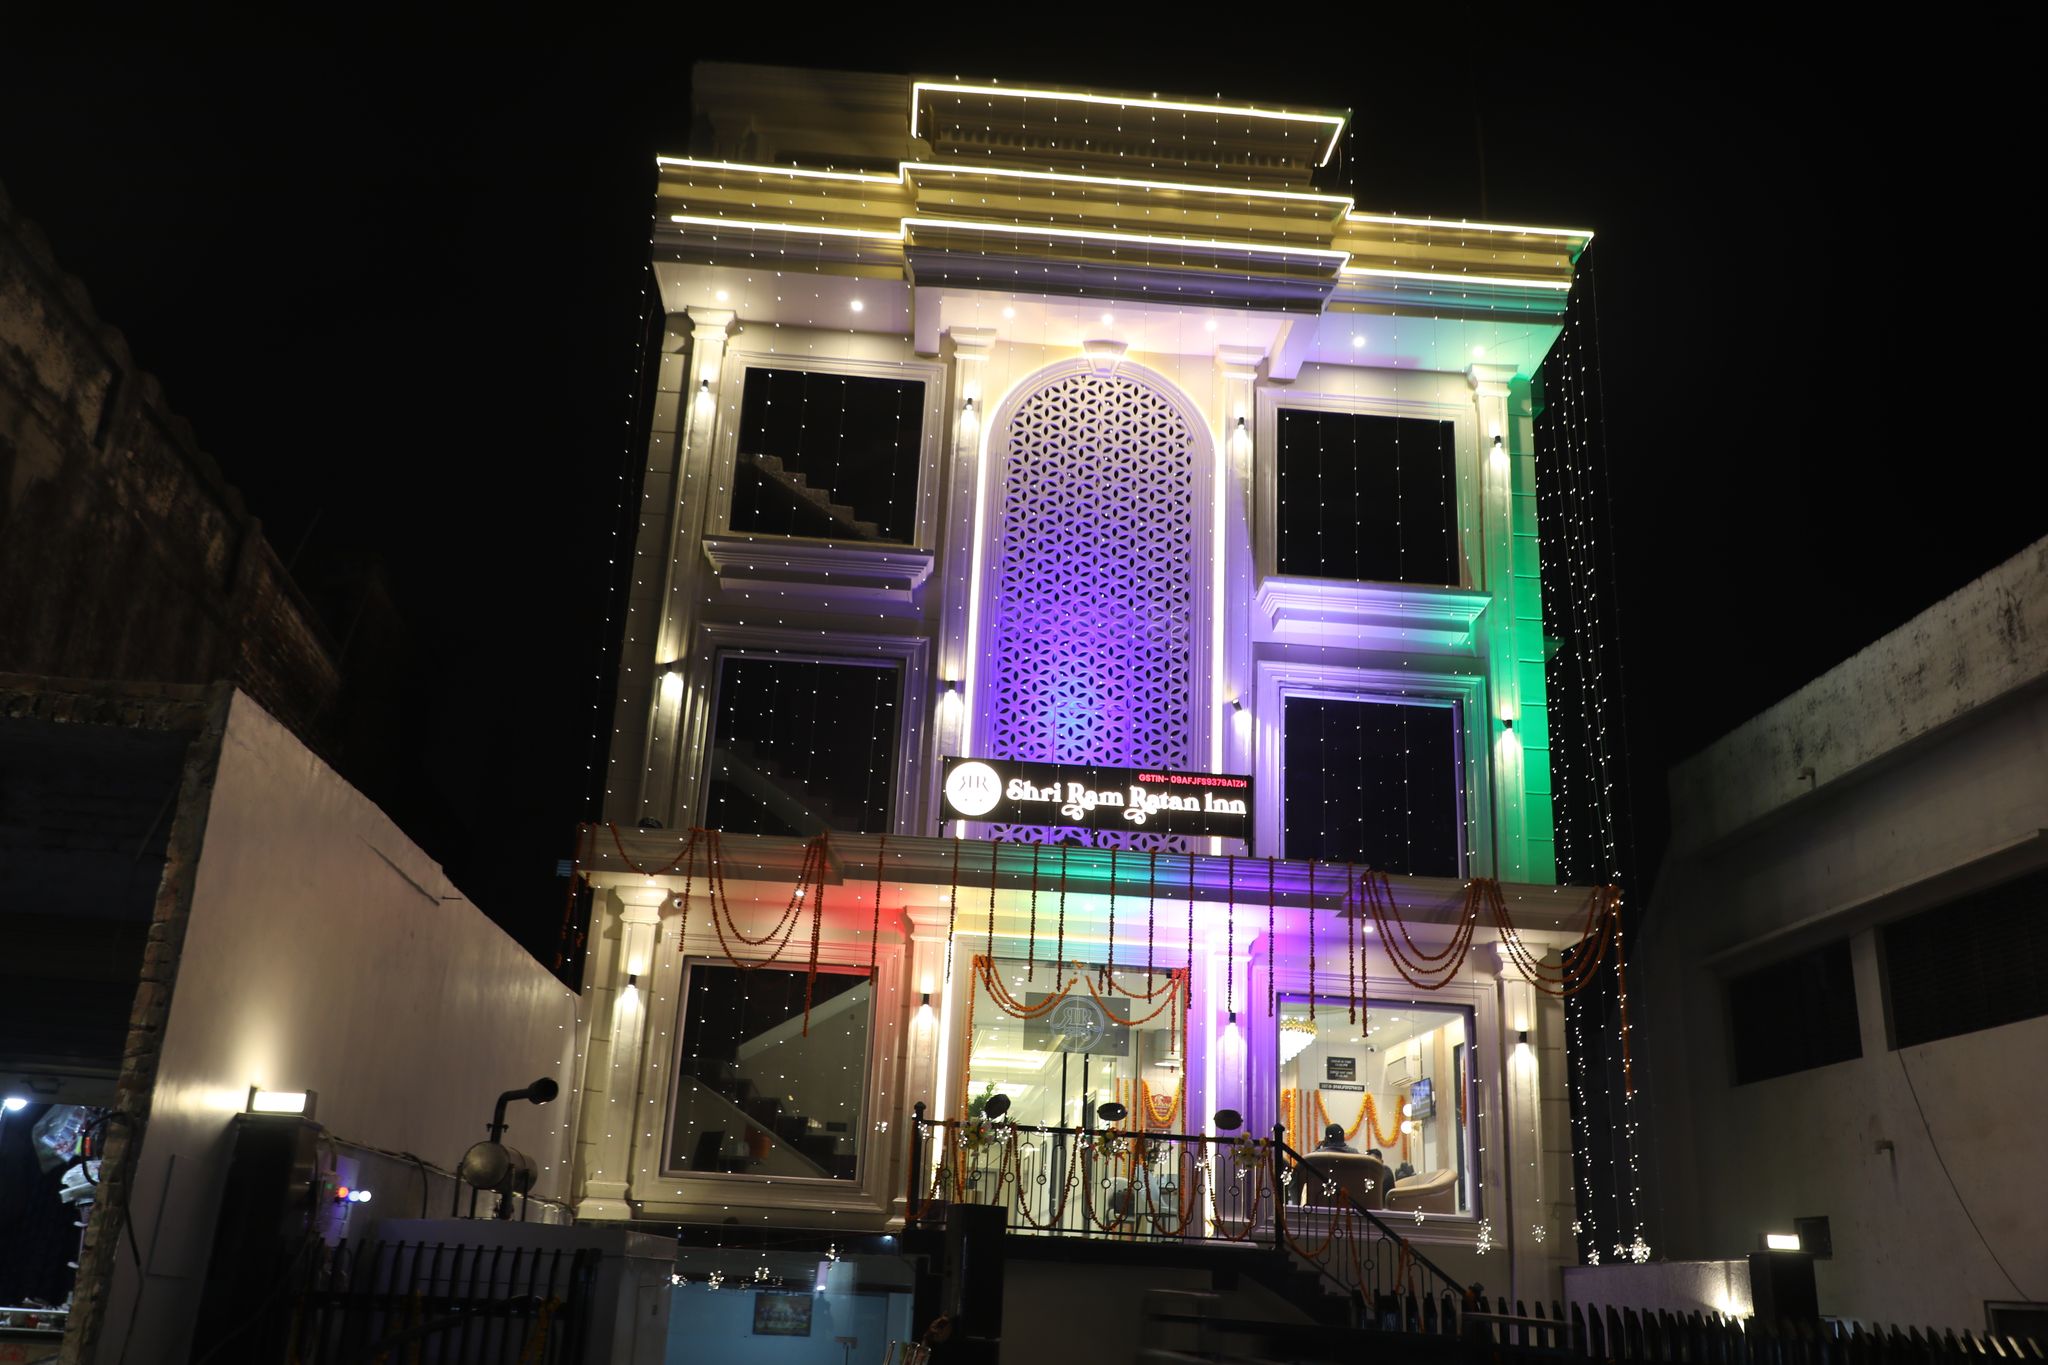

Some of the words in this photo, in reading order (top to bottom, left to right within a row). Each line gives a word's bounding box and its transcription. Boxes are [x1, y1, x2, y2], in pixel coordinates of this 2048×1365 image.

[1138, 773, 1169, 783] GSTIN-
[1006, 778, 1062, 803] Shri
[1061, 782, 1124, 820] Ram
[1124, 784, 1201, 825] Ratan
[1204, 792, 1247, 815] Inn
